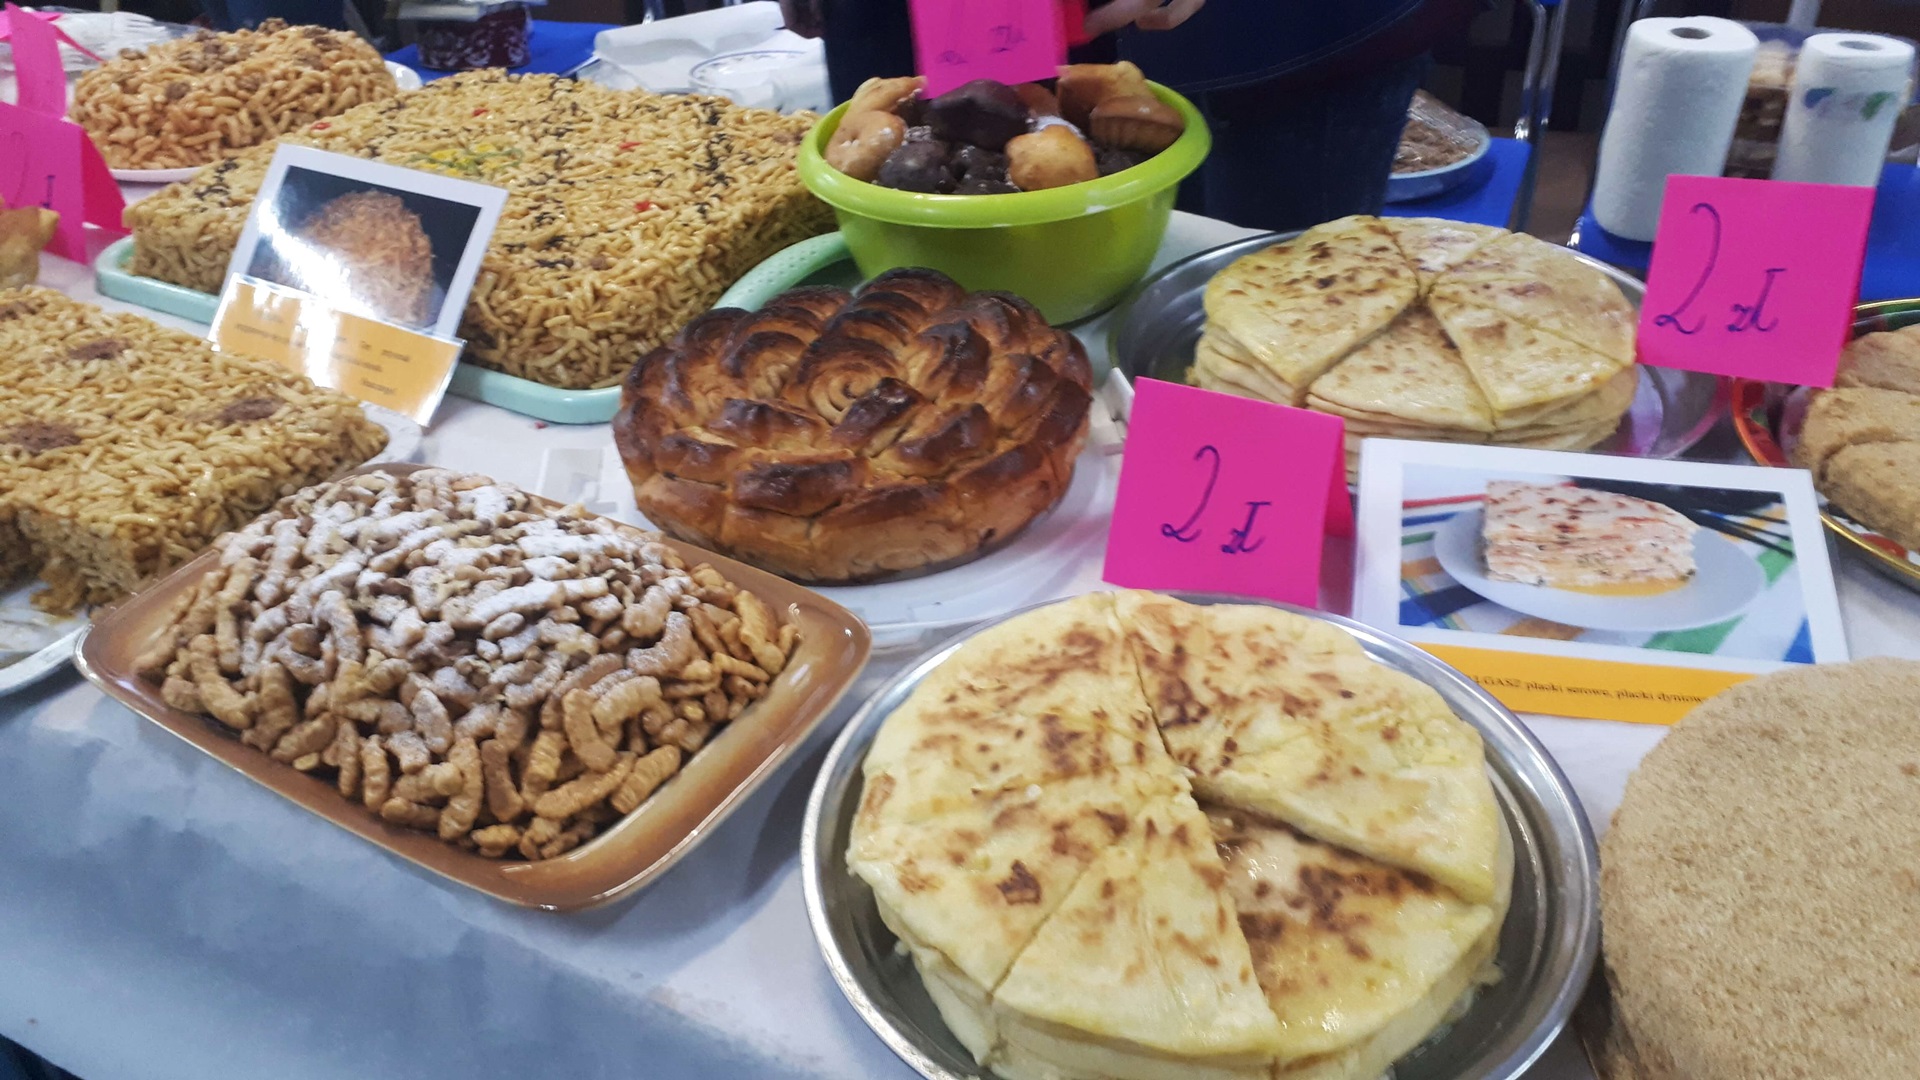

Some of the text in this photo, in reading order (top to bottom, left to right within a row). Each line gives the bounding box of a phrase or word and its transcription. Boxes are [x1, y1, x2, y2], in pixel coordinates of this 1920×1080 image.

[1654, 202, 1722, 335] 2
[1160, 444, 1220, 543] 2
[1657, 690, 1704, 705] dyniow
